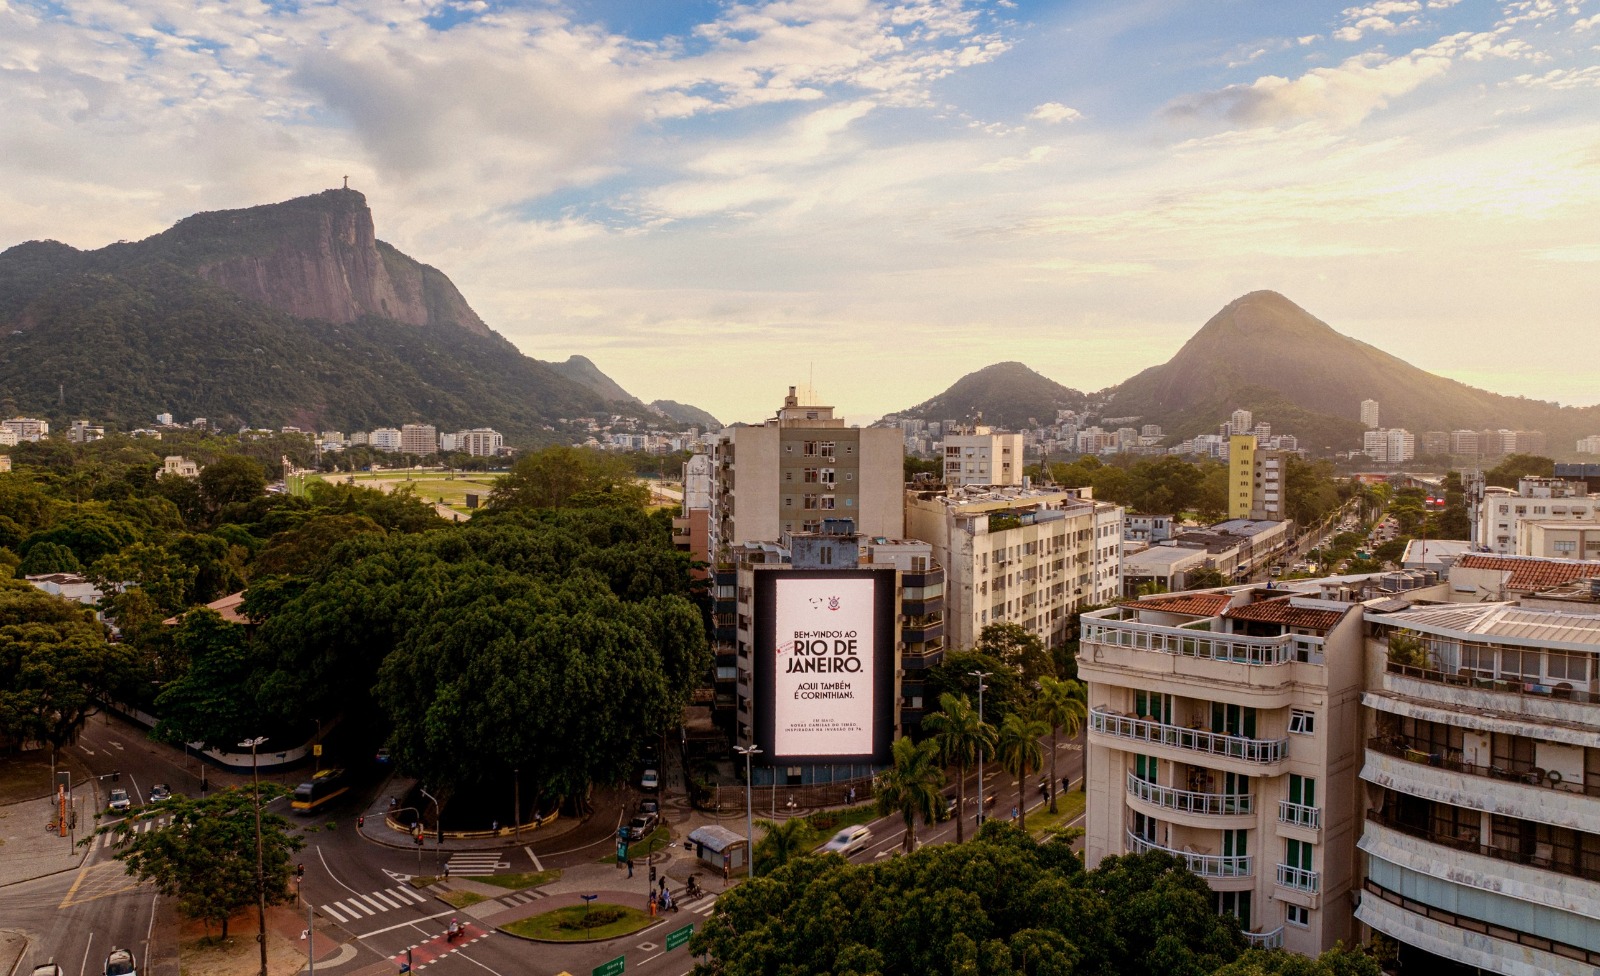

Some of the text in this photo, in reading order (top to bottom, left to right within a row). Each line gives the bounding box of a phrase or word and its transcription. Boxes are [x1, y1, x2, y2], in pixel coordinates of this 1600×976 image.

[794, 630, 857, 639] BEM-VINDOS AO
[794, 640, 828, 656] RIO
[834, 640, 857, 656] DE
[786, 657, 864, 673] JANEIRO.
[798, 680, 851, 690] AQUI TAMBÉM
[794, 690, 854, 699] É CORINTHIANS.
